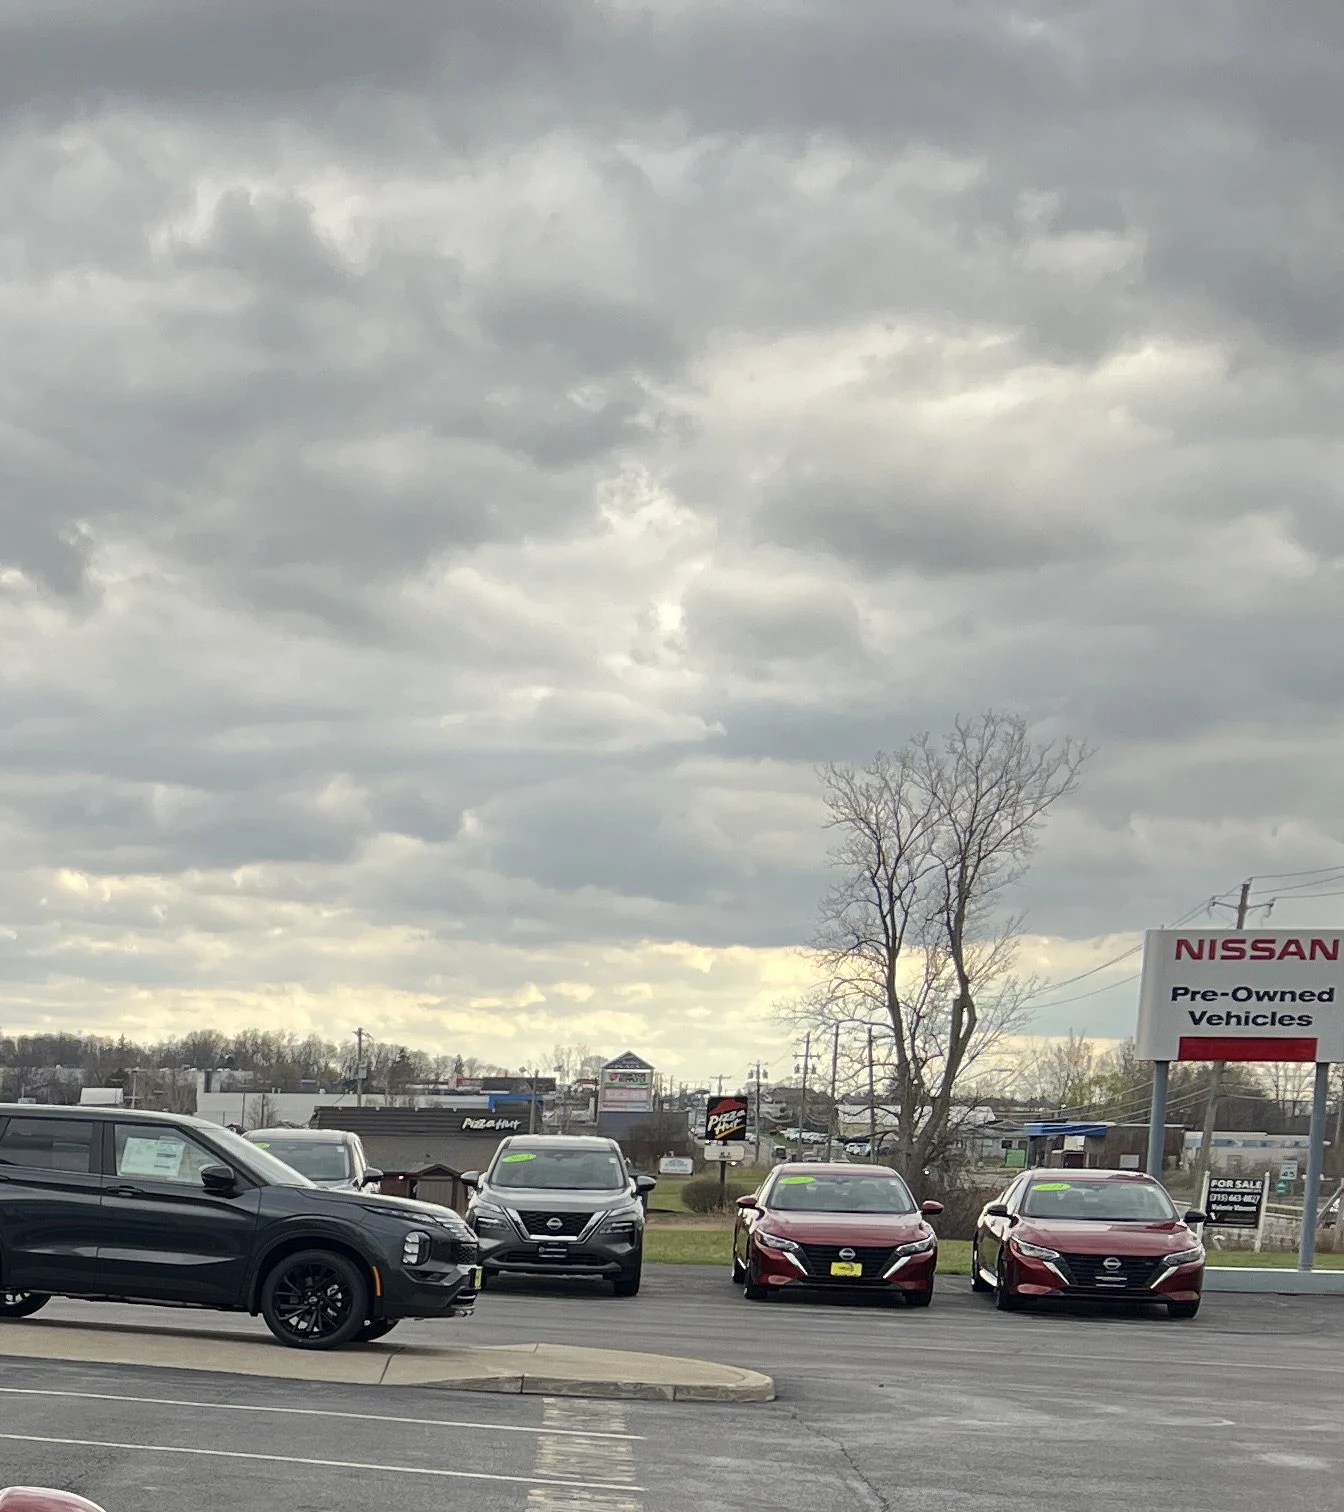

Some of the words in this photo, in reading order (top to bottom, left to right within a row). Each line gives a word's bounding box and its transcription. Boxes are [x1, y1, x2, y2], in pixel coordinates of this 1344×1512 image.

[1175, 938, 1340, 961] NISSAN
[1171, 986, 1335, 1003] Pre-Owned
[1188, 1010, 1313, 1027] Vehicles
[462, 1118, 495, 1129] Pizza
[495, 1118, 521, 1130] Hut
[708, 1110, 746, 1131] Pizza
[714, 1119, 743, 1135] Hut
[1211, 1179, 1233, 1187] FOR
[1235, 1180, 1262, 1188] SALE
